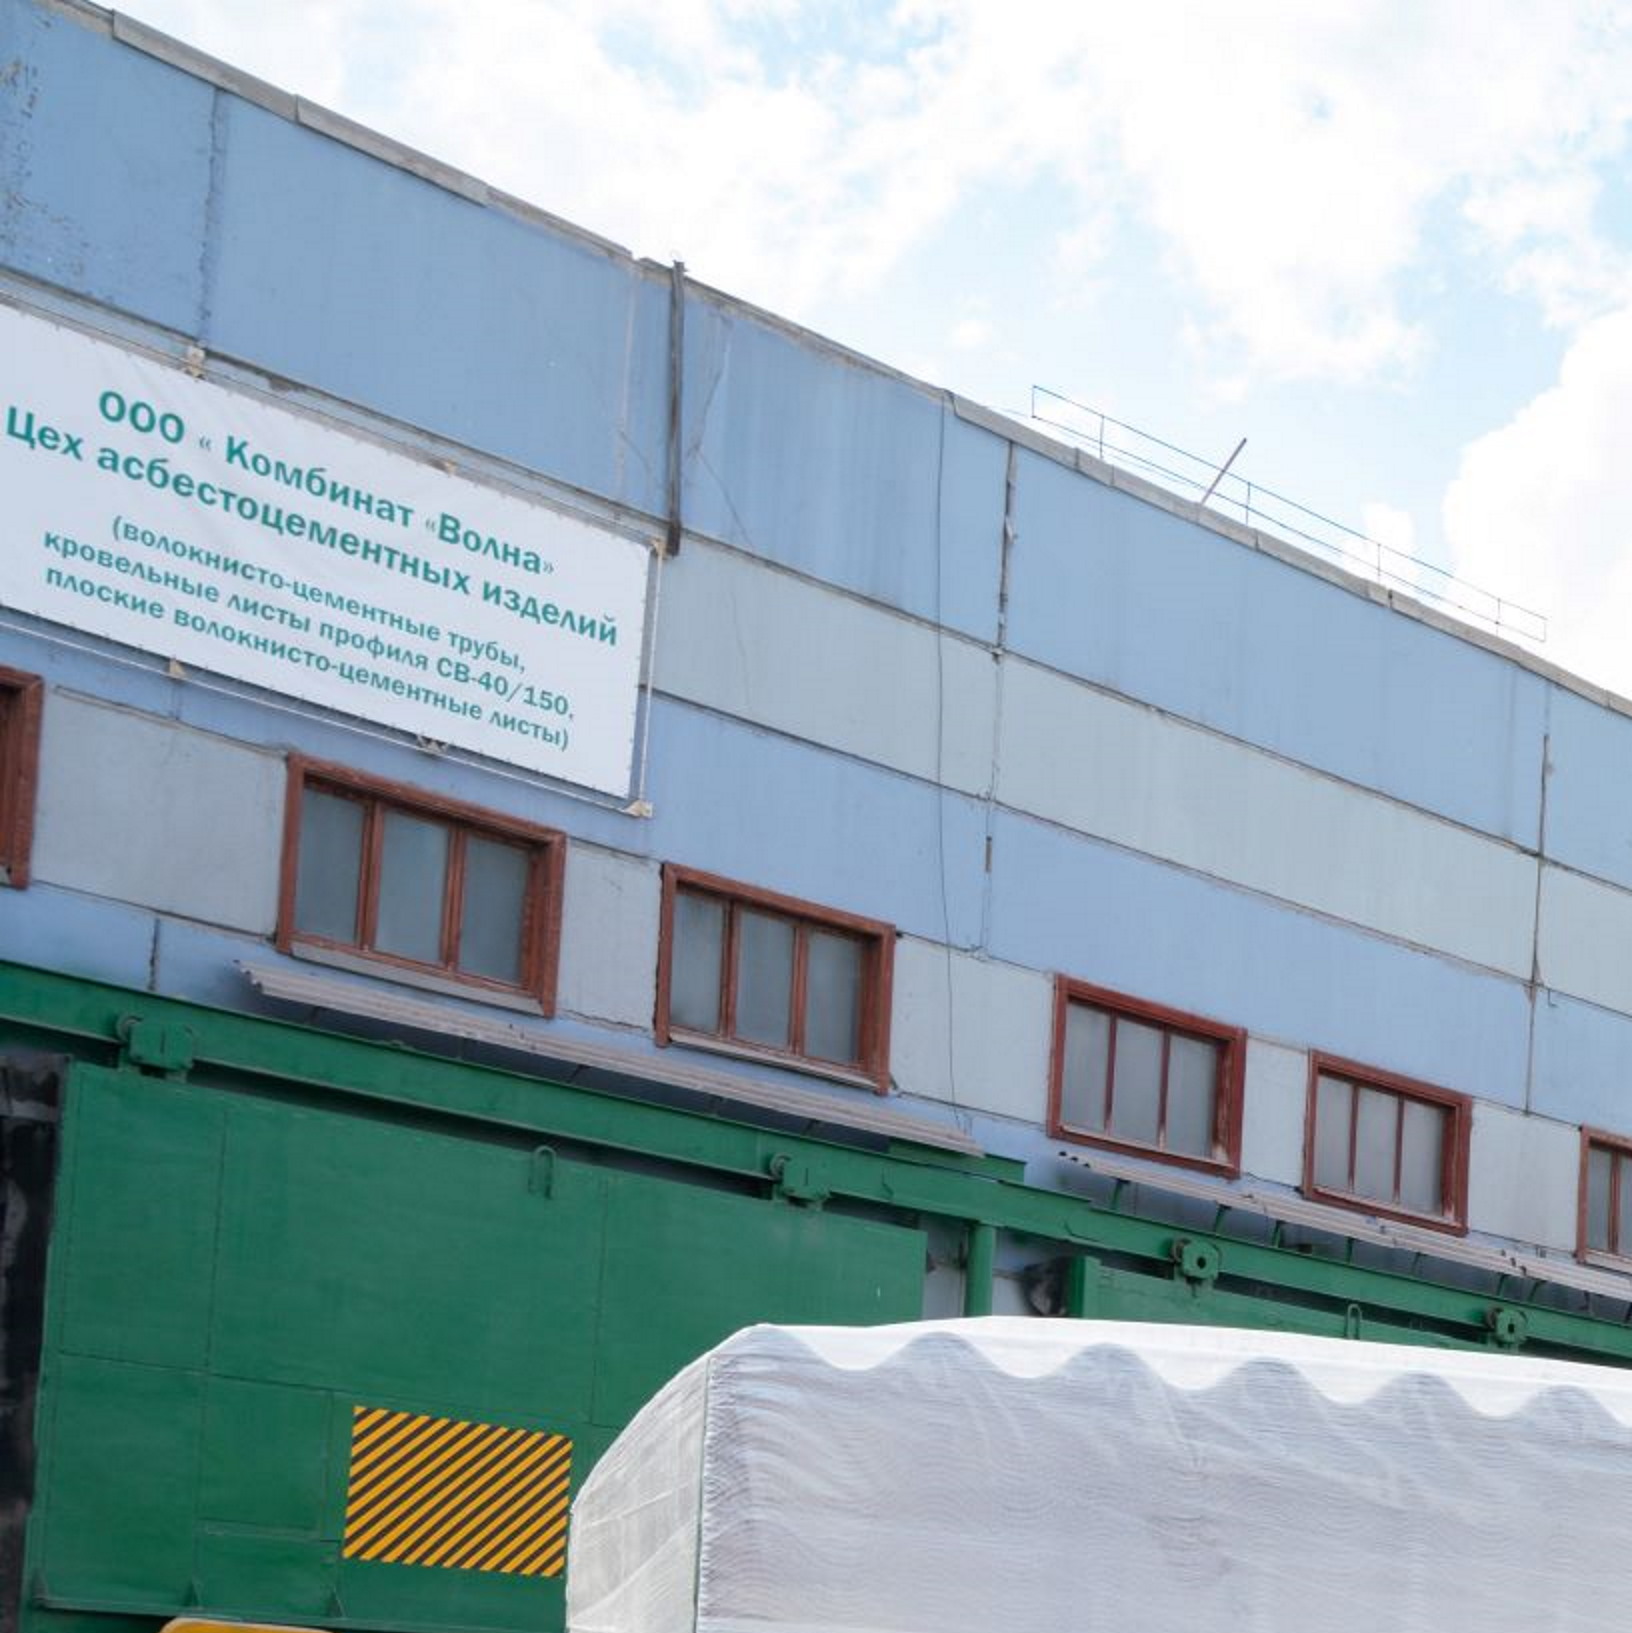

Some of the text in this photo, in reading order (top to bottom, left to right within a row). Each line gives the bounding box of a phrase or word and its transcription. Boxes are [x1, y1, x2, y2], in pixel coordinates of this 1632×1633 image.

[6, 405, 618, 647] Цех асбестоцементных изделий
[100, 391, 185, 444] ООО
[226, 435, 414, 528] Комбинат
[44, 531, 220, 602] кровельные
[228, 594, 311, 634] листы
[319, 620, 429, 671] профиля
[46, 567, 569, 752] плоские волокнисто-цементные листы)
[112, 515, 526, 674] (волокнисто-цементные трубы,
